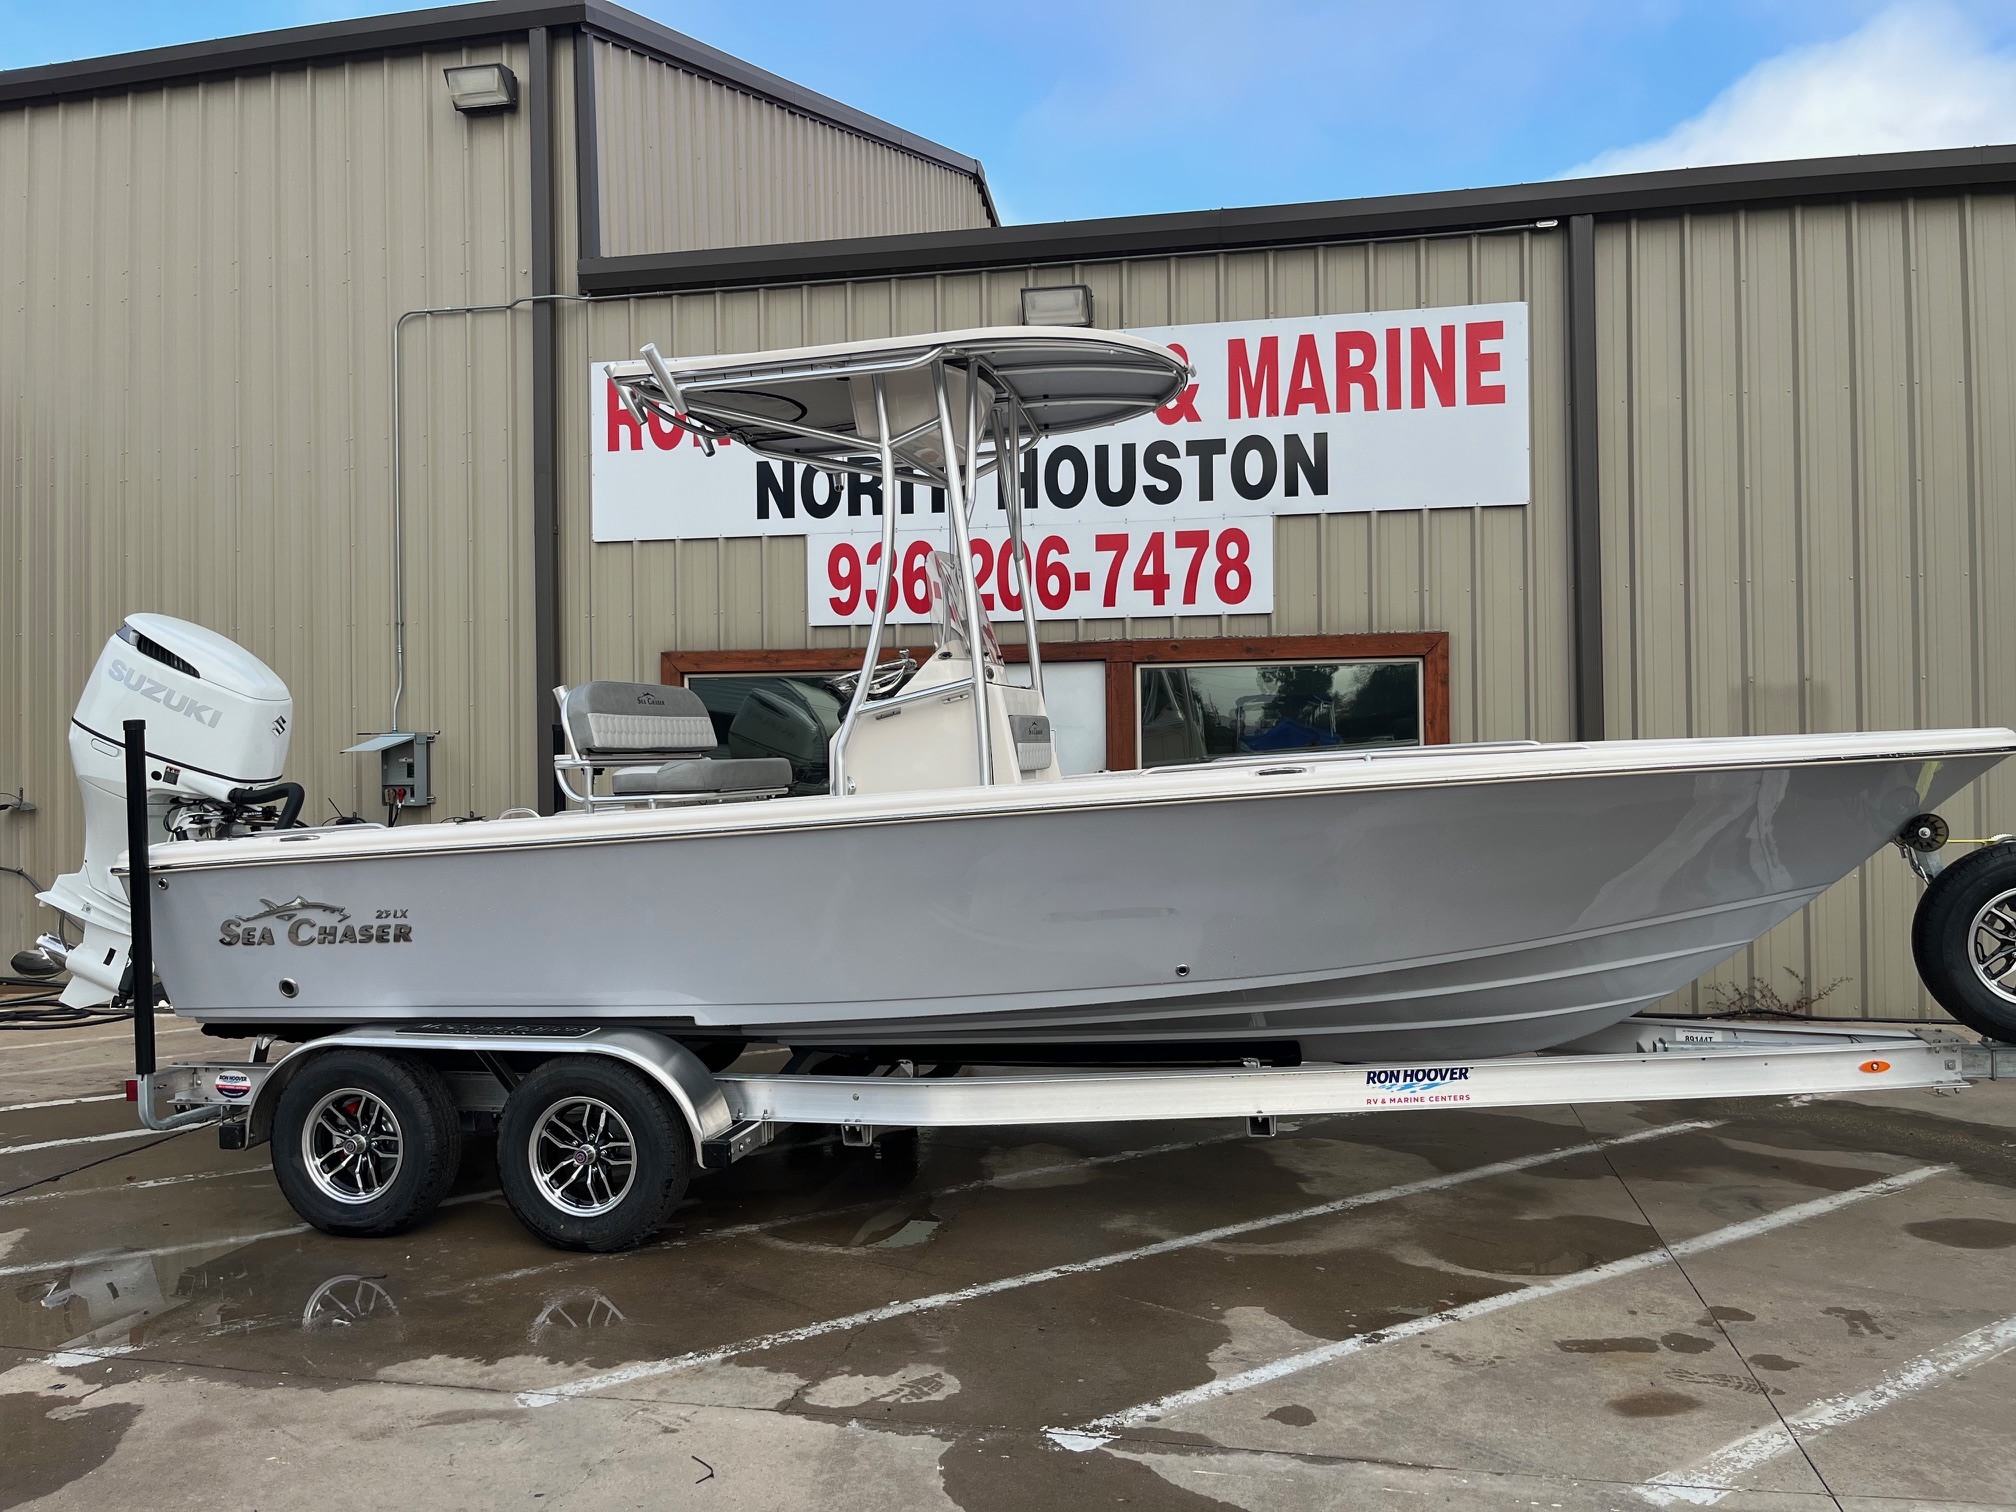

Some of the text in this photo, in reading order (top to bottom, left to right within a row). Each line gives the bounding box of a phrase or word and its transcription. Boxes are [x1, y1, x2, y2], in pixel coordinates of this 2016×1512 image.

[1227, 320, 1506, 420] MARINE
[997, 432, 1329, 512] HOUSTON
[827, 527, 1252, 617] 936-206-7478
[108, 659, 224, 729] SUZUKI
[219, 917, 413, 947] SEA CHASER
[1366, 1067, 1469, 1085] RON HOOVER
[1389, 1096, 1426, 1104] MARINE
[1428, 1094, 1471, 1103] CENTERS
